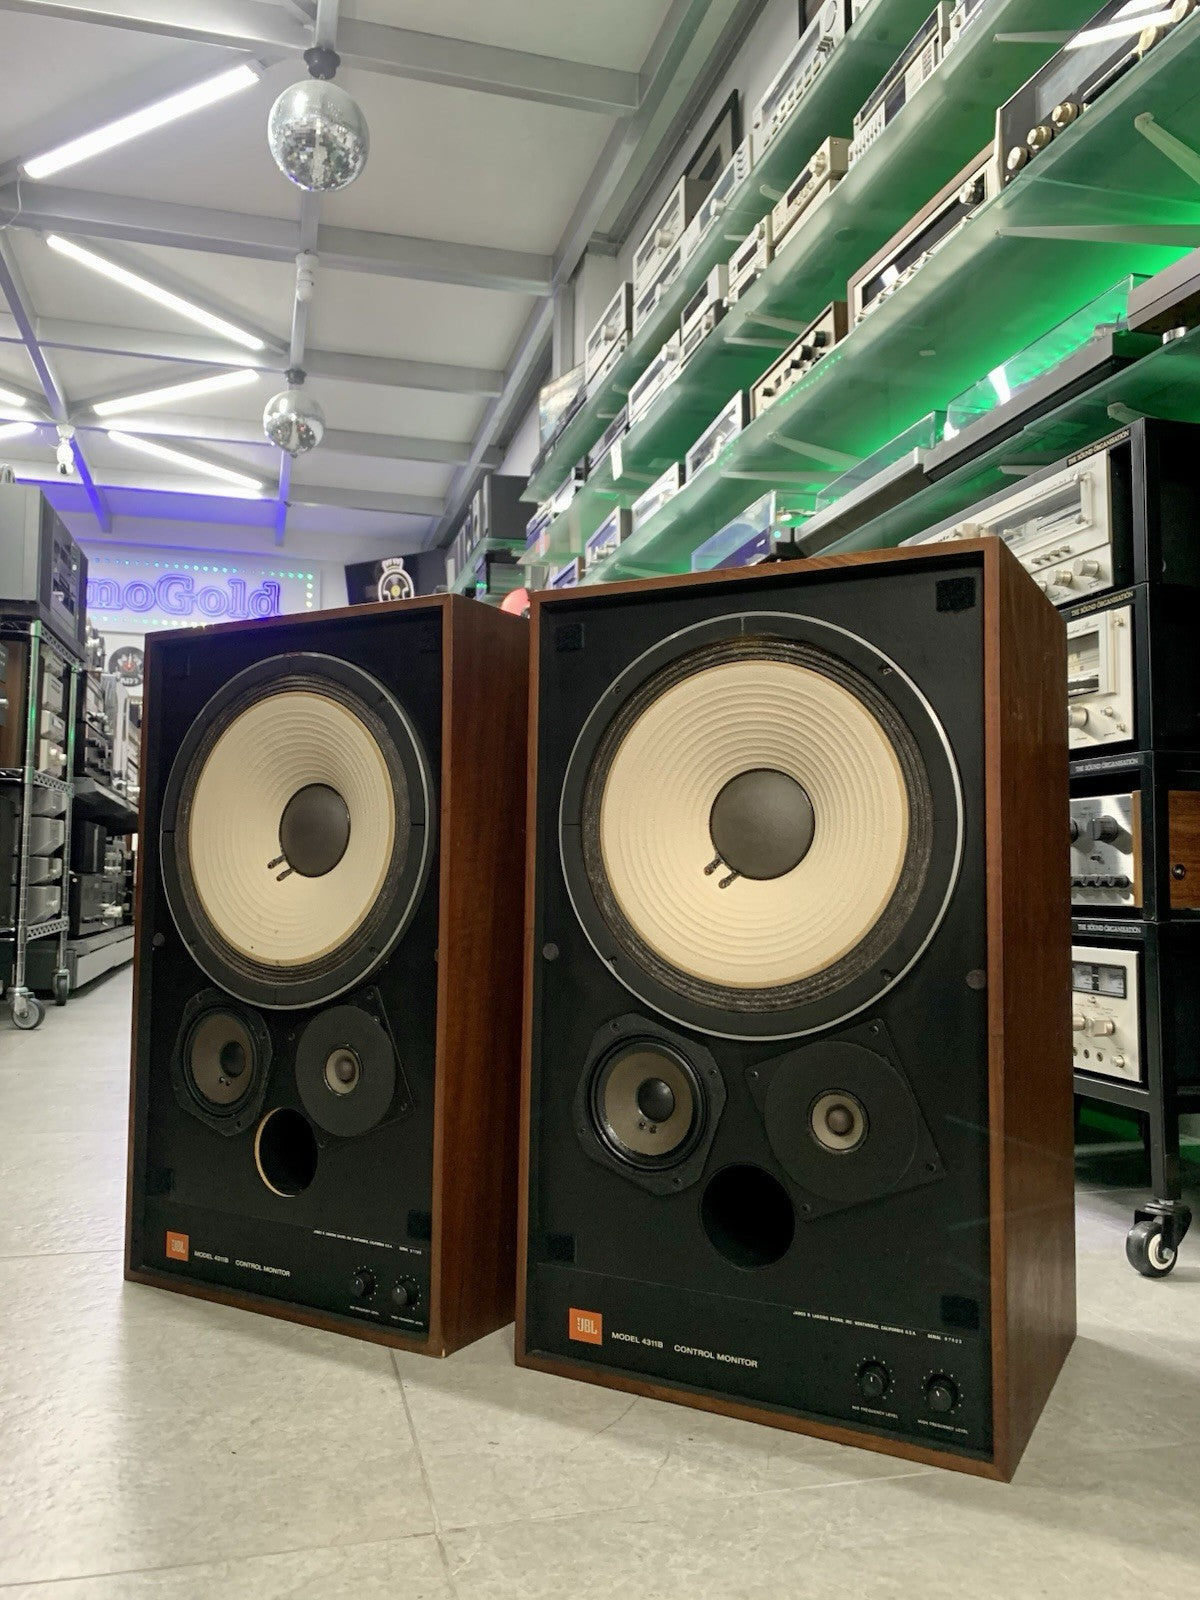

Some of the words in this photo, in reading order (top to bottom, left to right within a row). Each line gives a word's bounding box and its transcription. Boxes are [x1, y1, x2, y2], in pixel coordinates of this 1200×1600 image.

[1080, 603, 1097, 614] SOUND
[1084, 763, 1101, 771] SOUND
[1087, 923, 1104, 932] SOUND
[194, 1250, 213, 1261] MODEL
[235, 1259, 262, 1272] CONTROL
[263, 1265, 291, 1278] MONITOR
[576, 1317, 598, 1335] JBL
[611, 1331, 640, 1344] MODEL
[641, 1337, 664, 1349] 4311B
[673, 1344, 714, 1360] CONTROL
[716, 1353, 758, 1368] MONITOR
